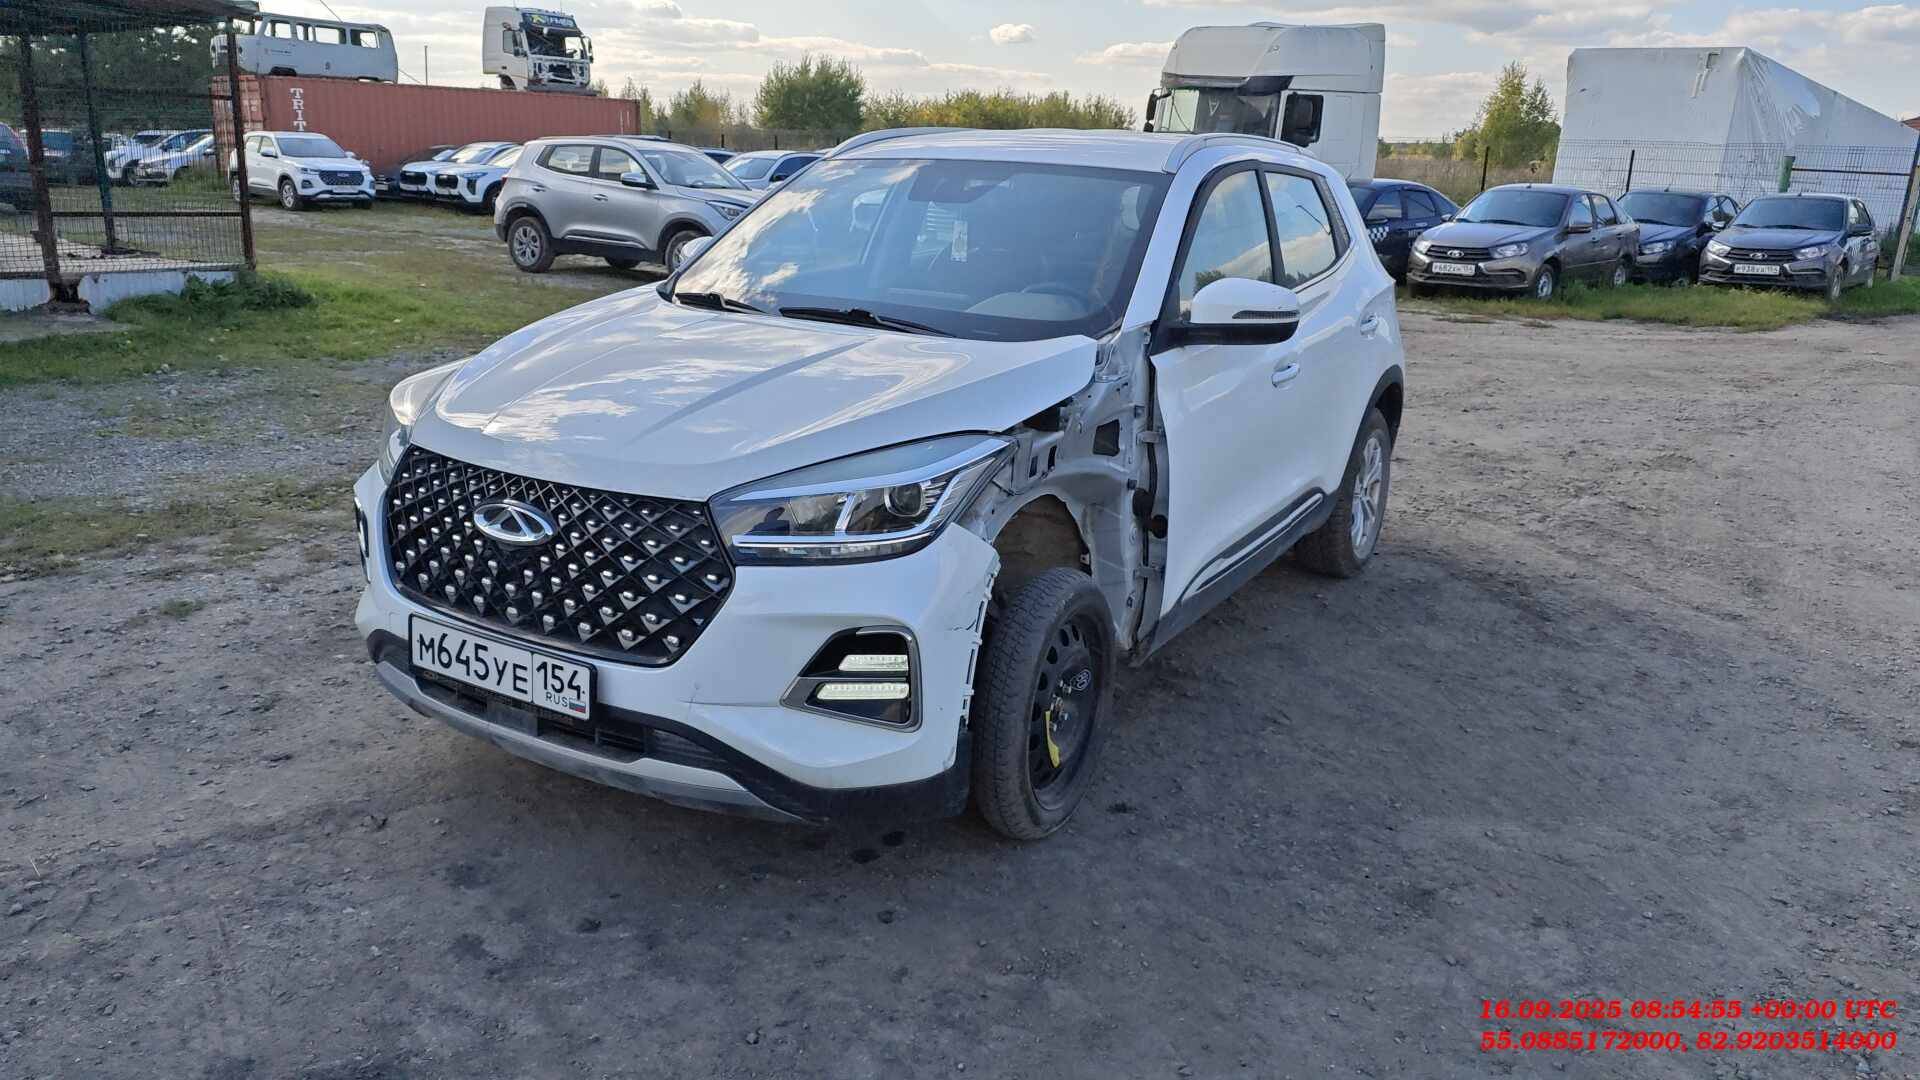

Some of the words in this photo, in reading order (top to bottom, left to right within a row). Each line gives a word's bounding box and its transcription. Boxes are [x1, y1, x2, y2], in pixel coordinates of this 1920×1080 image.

[418, 633, 529, 694] М645УЕ
[536, 661, 582, 700] 154
[546, 691, 569, 707] RUS
